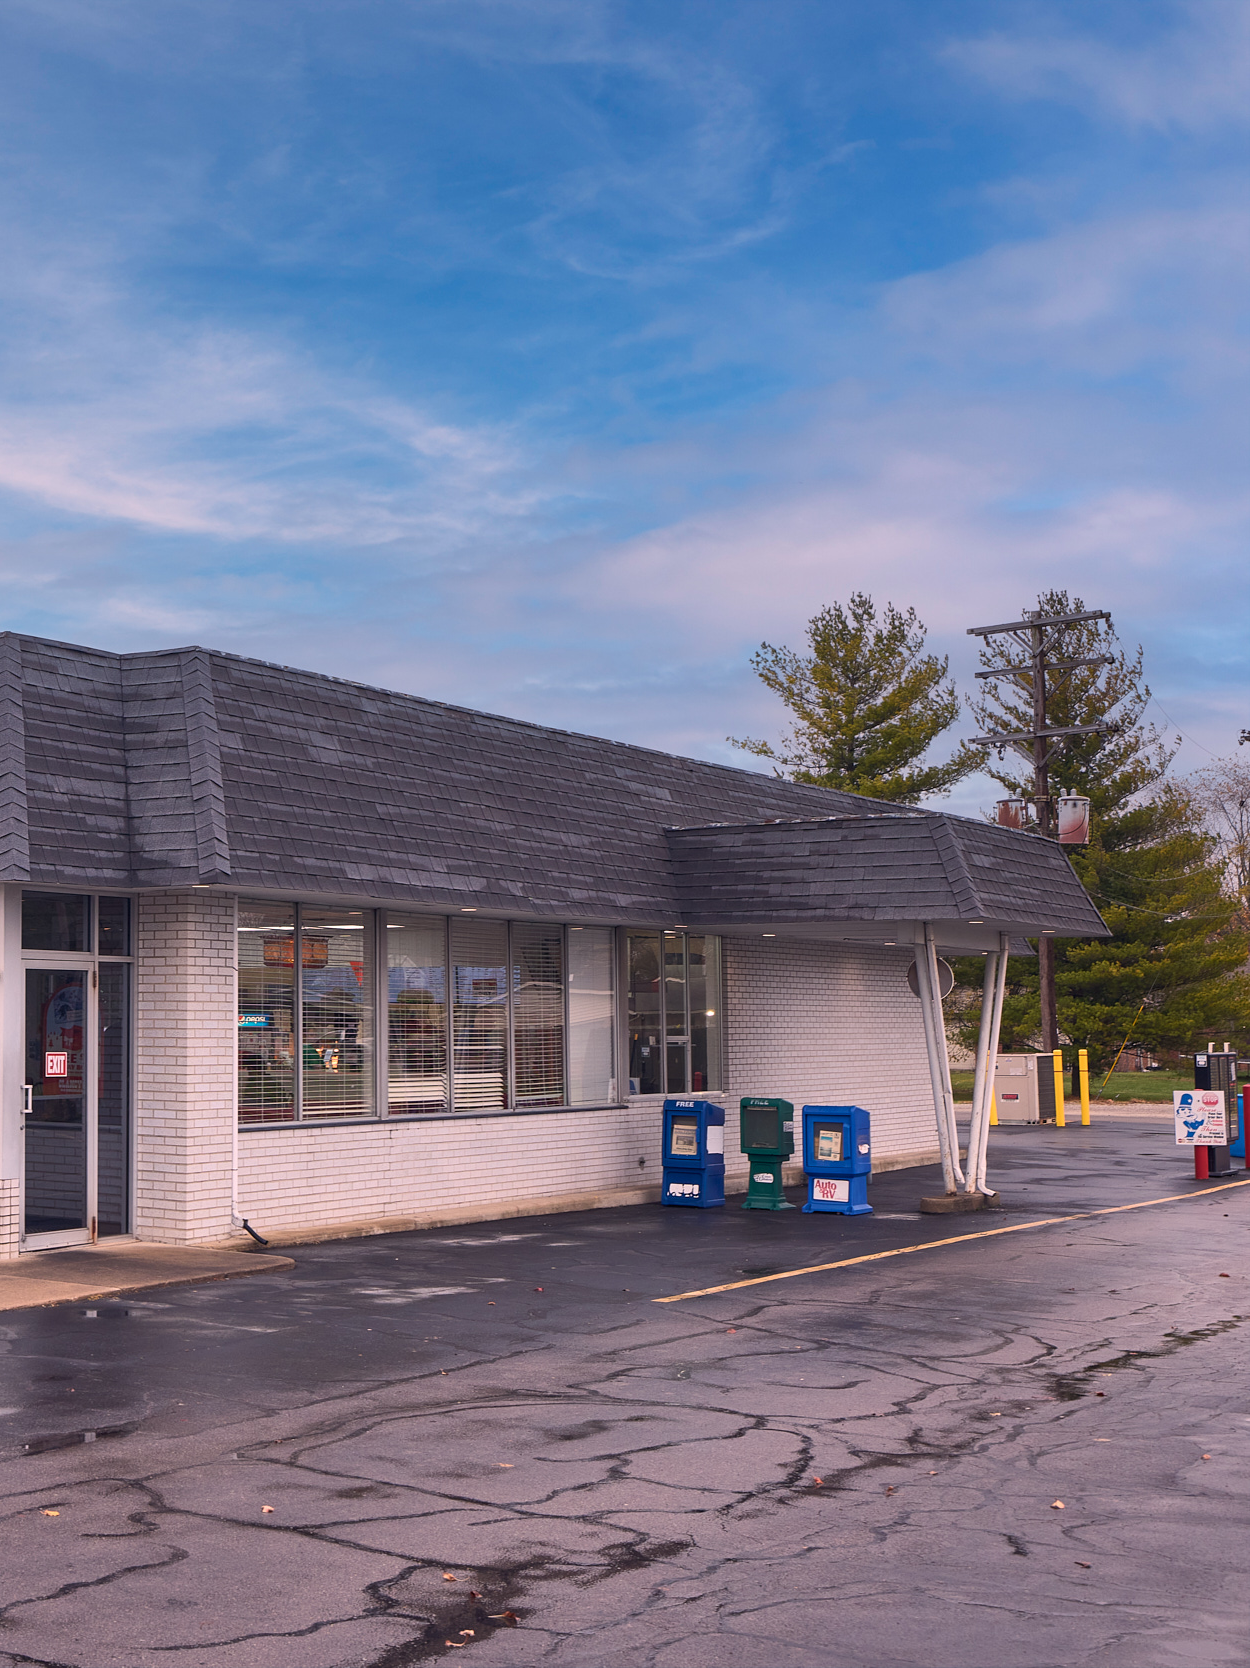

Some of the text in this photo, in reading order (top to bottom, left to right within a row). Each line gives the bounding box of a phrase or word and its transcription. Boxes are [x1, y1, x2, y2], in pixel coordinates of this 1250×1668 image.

[245, 1016, 266, 1025] pepsi
[47, 1055, 66, 1074] EXIT
[815, 1179, 837, 1191] Auto
[822, 1189, 836, 1199] RV
